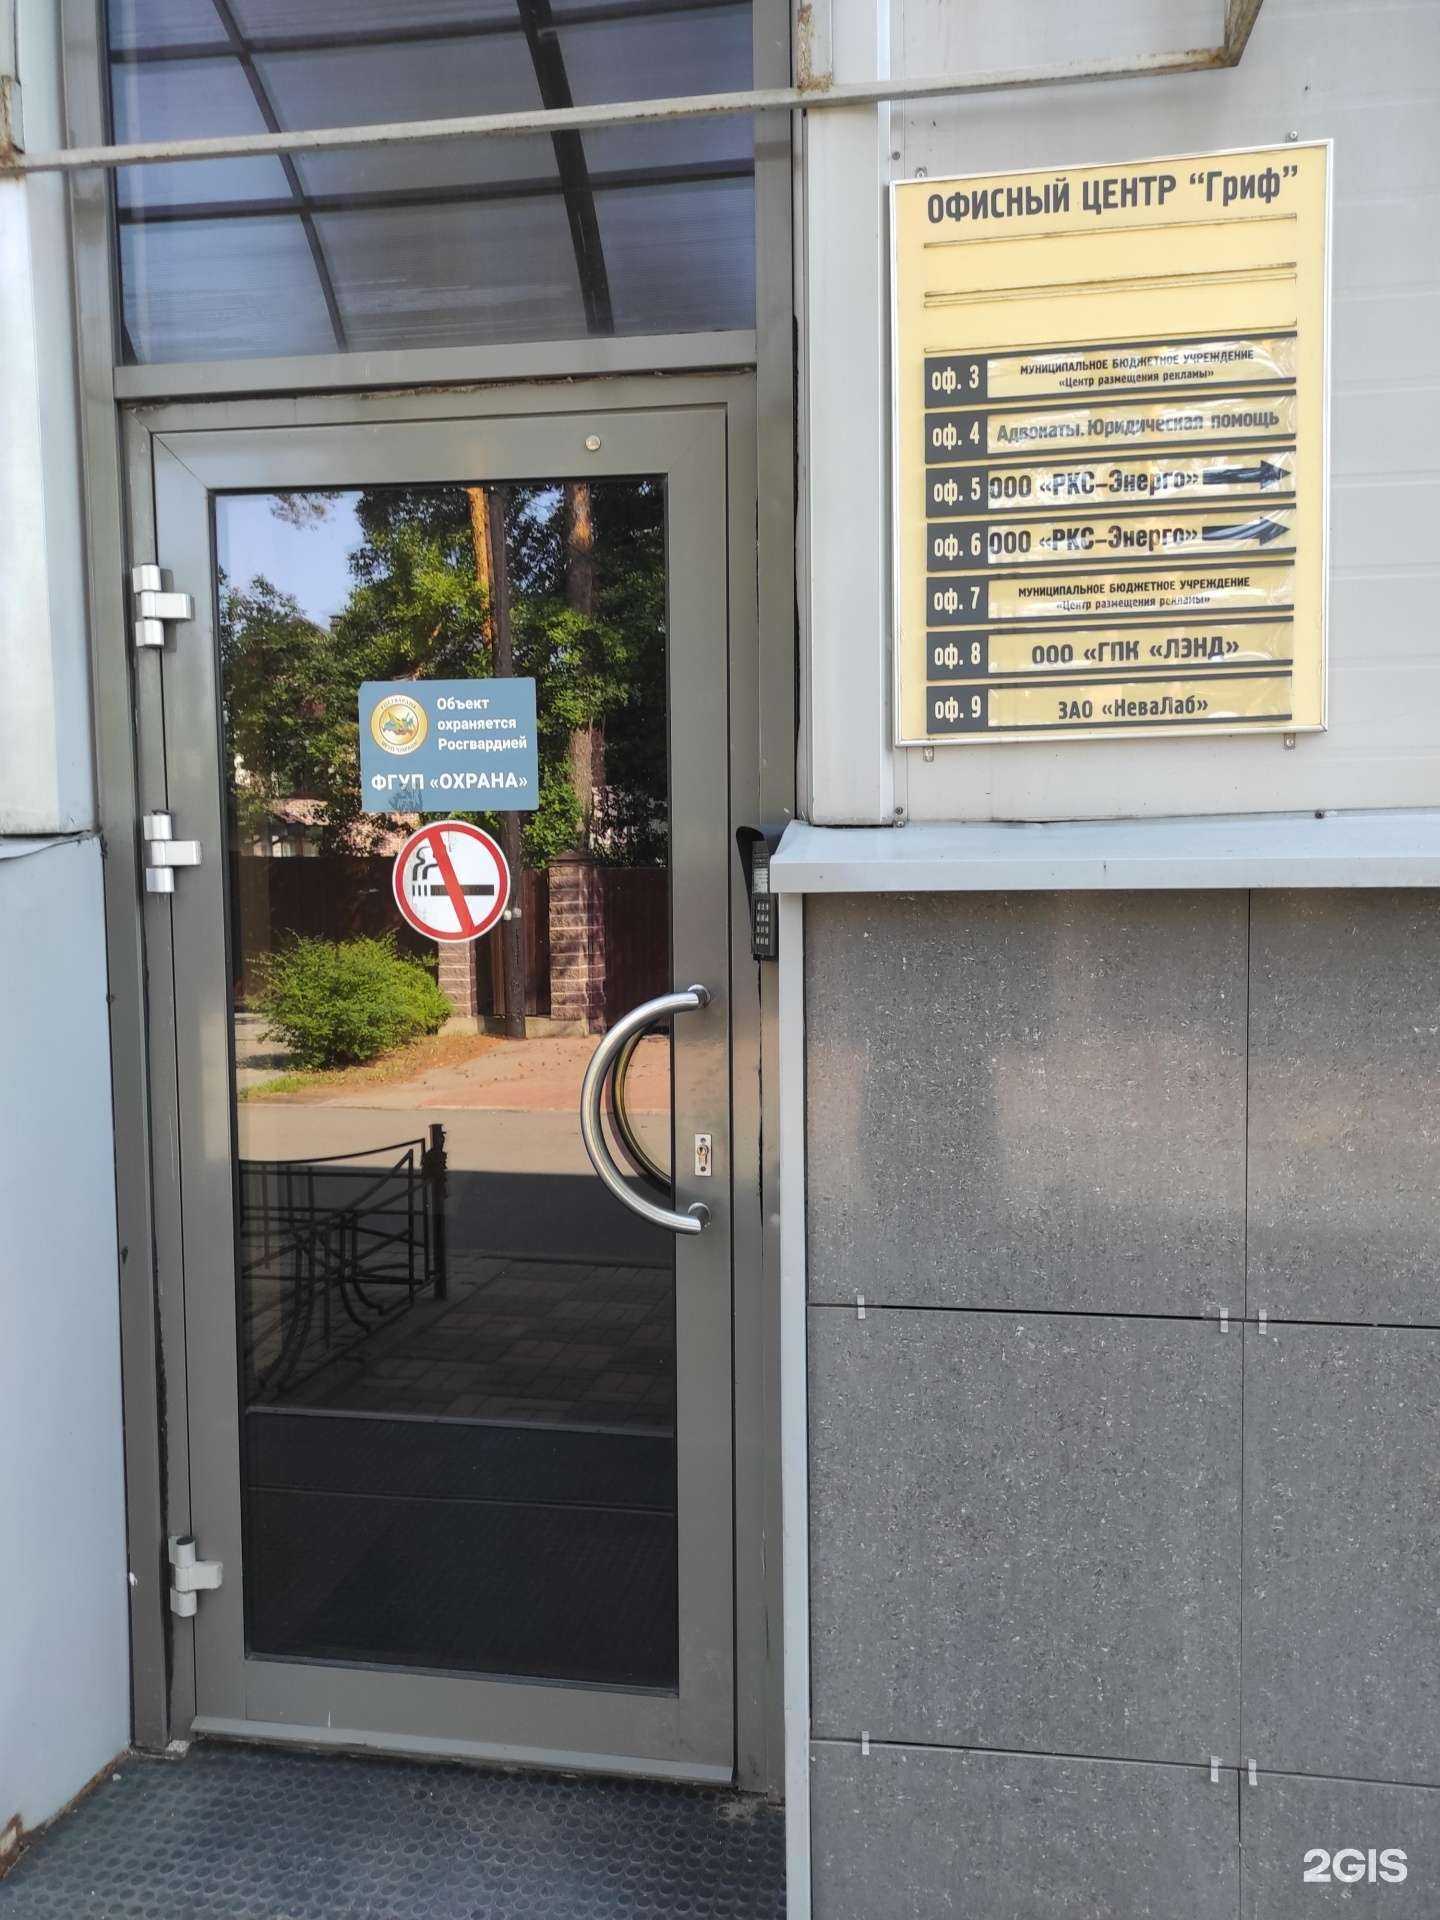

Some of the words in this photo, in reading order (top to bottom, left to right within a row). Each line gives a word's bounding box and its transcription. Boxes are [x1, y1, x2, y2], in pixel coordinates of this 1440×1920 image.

[927, 176, 1070, 224] ОФИСНЫЙ
[1082, 174, 1177, 216] ЦЕНТР
[1020, 359, 1108, 376] МУНИЦИПАЛЬНОЕ
[1112, 354, 1179, 370] БЮДЖЕТНОЕ
[1183, 349, 1255, 365] УЧРЕЖДЕНИЕ
[931, 366, 962, 394] оф.
[968, 364, 980, 389] 3
[1058, 377, 1094, 389] «Центр
[1097, 373, 1159, 386] размещения
[1162, 369, 1214, 381] рекламы»
[1211, 411, 1279, 430] помощь
[932, 422, 963, 450] оф.
[969, 421, 980, 445] 4
[933, 478, 963, 506] оф.
[970, 477, 981, 501] 5
[989, 474, 1032, 499] ООО
[934, 533, 964, 561] оф.
[970, 532, 981, 556] 6
[989, 530, 1032, 555] ООО
[1018, 583, 1105, 598] МУНИЦИПАЛЬНОЕ
[1109, 580, 1176, 594] БЮДЖЕТНОЕ
[1180, 576, 1250, 590] УЧРЕЖДЕНИЕ
[933, 587, 964, 615] оф.
[970, 586, 981, 609] 7
[1095, 597, 1156, 609] размещения
[934, 642, 964, 670] оф.
[970, 641, 981, 665] 8
[1031, 643, 1074, 664] ООО
[1083, 640, 1140, 662] «ГПК
[1149, 635, 1240, 660] «ЛЭНД»
[436, 696, 490, 711] Объект
[934, 696, 964, 723] оф.
[971, 695, 982, 718] 9
[1058, 700, 1093, 720] ЗАО
[1102, 695, 1209, 717] «НеваЛаб»
[437, 718, 517, 733] охраняется
[438, 736, 528, 752] Росгвардией
[371, 773, 425, 791] ФГУП
[430, 772, 528, 790] «ОХРАНА»
